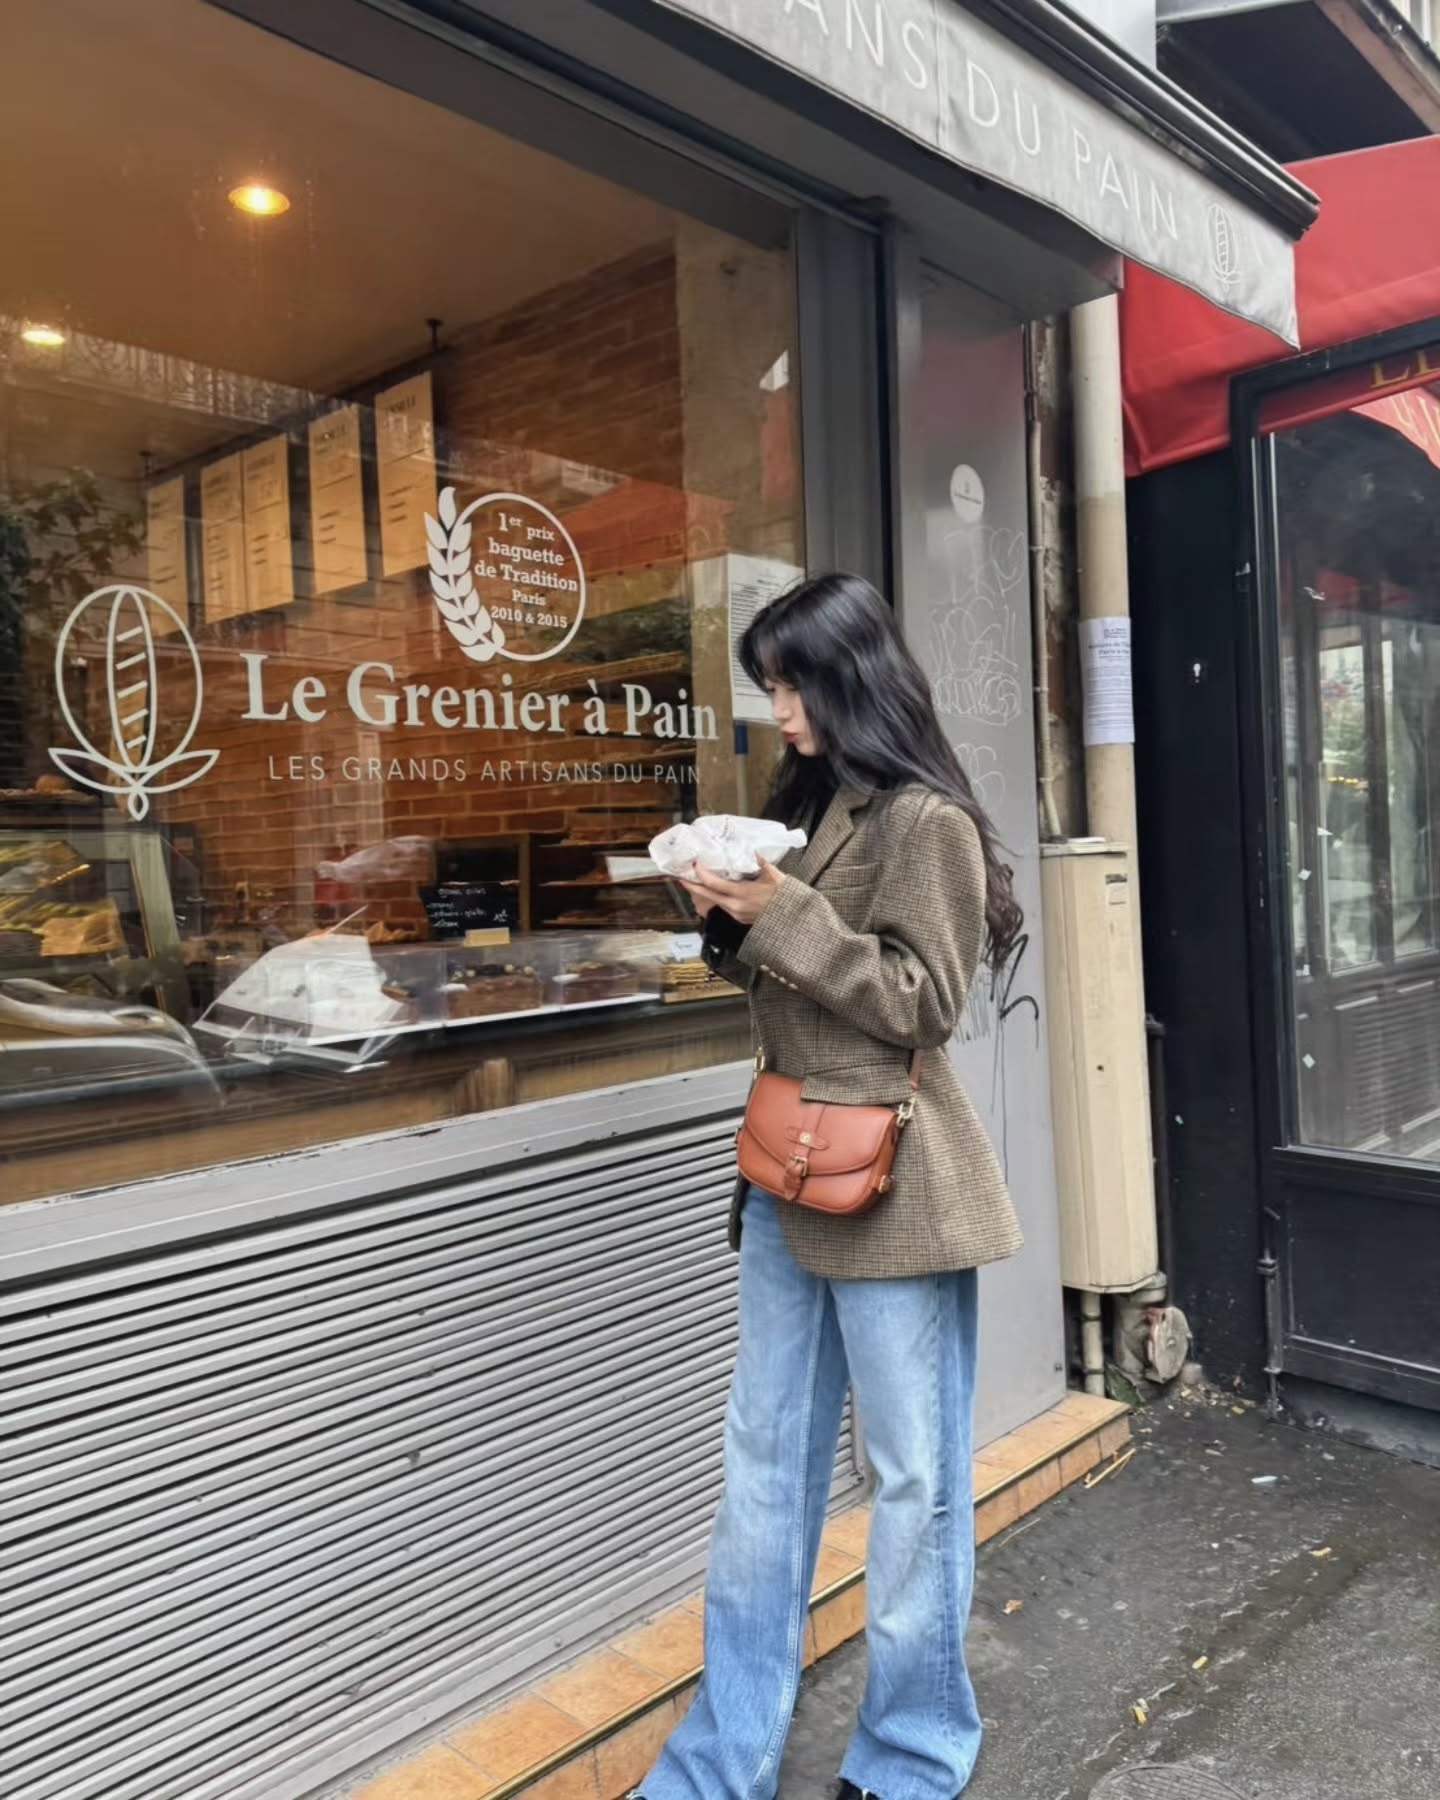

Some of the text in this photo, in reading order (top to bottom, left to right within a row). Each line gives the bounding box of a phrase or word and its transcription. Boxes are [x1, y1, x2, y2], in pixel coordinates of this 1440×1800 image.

[965, 59, 1041, 156] DU
[1072, 126, 1179, 241] PAIN
[526, 526, 555, 541] prix
[488, 537, 565, 566] baguette
[474, 560, 578, 592] de Tradition
[512, 589, 547, 606] Paris
[491, 606, 568, 630] 2010 & 2015
[239, 652, 721, 741] Le Grenier à Pain
[268, 754, 701, 785] LES GRANDS ARTISANS DU PAIN
